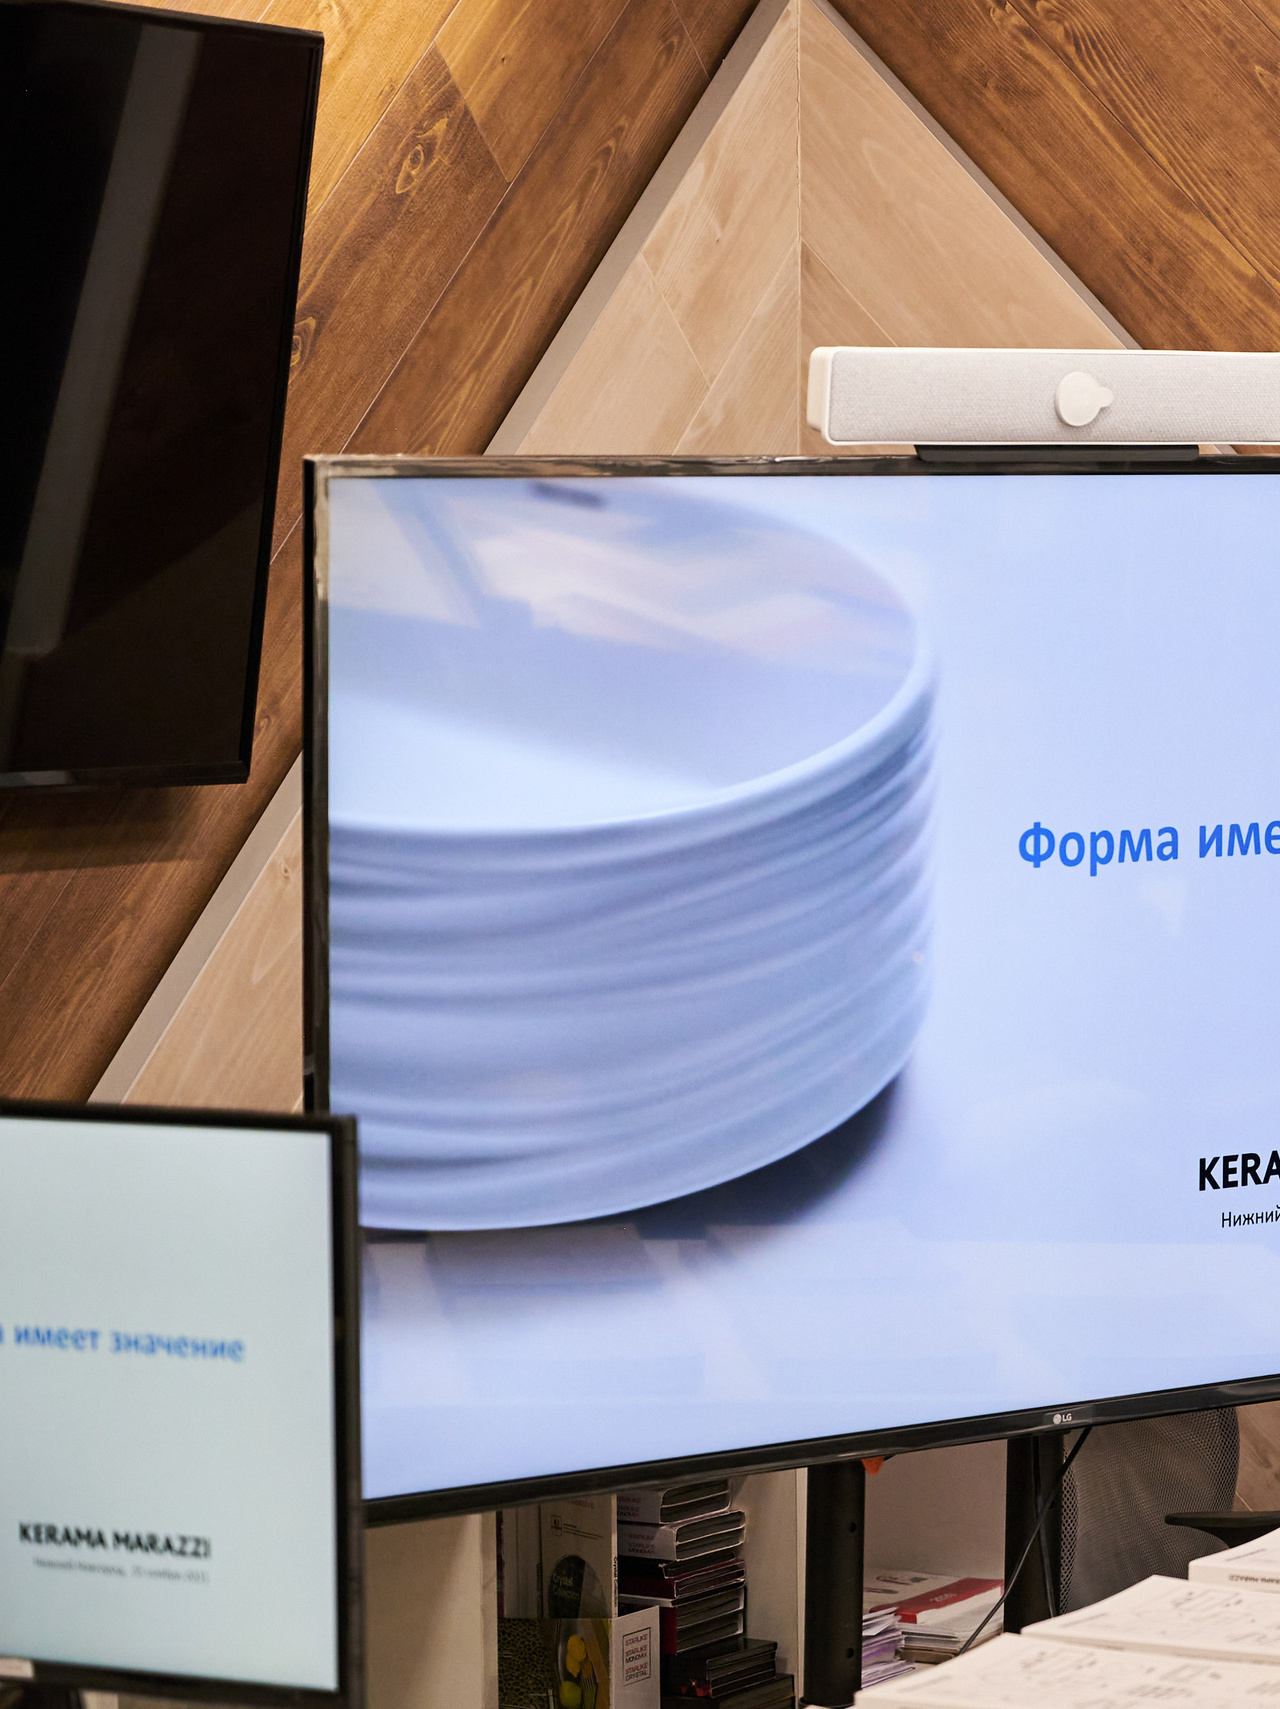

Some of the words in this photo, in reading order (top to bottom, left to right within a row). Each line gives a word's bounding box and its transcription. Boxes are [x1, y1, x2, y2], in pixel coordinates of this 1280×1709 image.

[1018, 821, 1179, 877] Форма
[14, 1325, 99, 1350] имеет
[110, 1330, 245, 1362] значение
[1062, 1413, 1072, 1422] LG
[18, 1522, 108, 1549] KERAMA
[113, 1529, 212, 1559] MARAZZI
